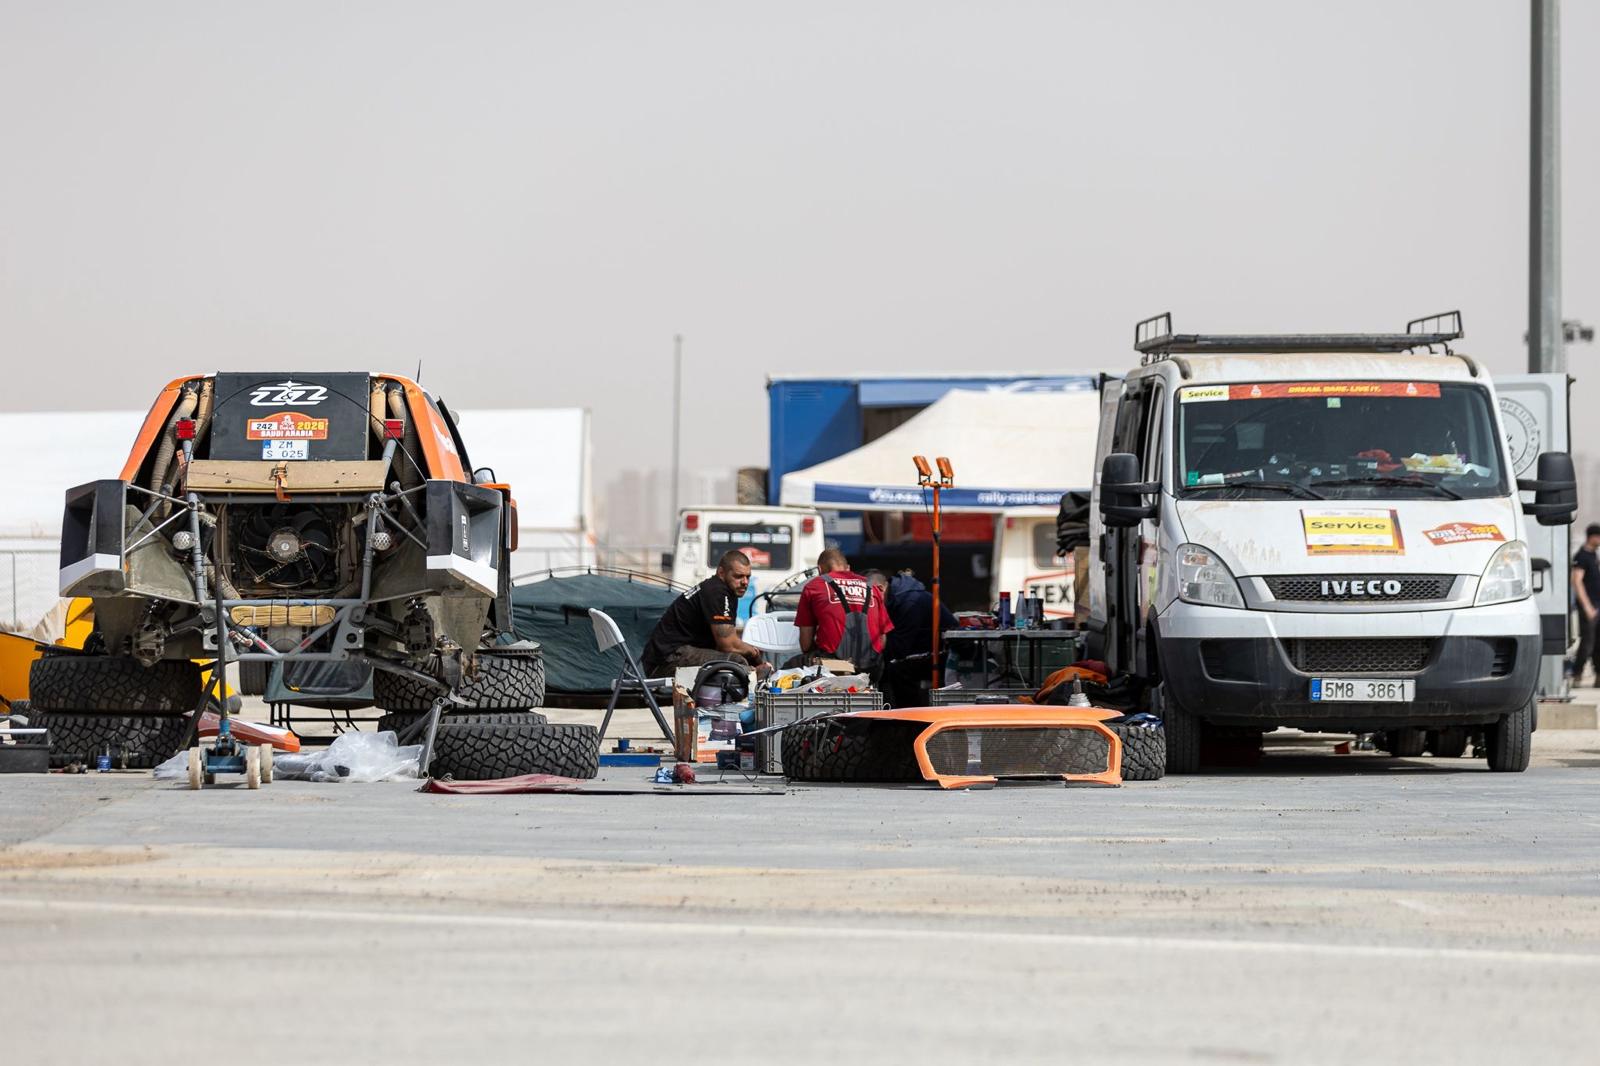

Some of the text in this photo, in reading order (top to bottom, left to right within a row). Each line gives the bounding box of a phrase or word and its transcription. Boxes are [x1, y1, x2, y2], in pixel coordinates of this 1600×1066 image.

[281, 450, 304, 458] 025
[1311, 521, 1386, 529] Service
[834, 585, 867, 599] PORT
[1321, 580, 1402, 595] IVECO
[1325, 682, 1405, 698] 5M8 3861
